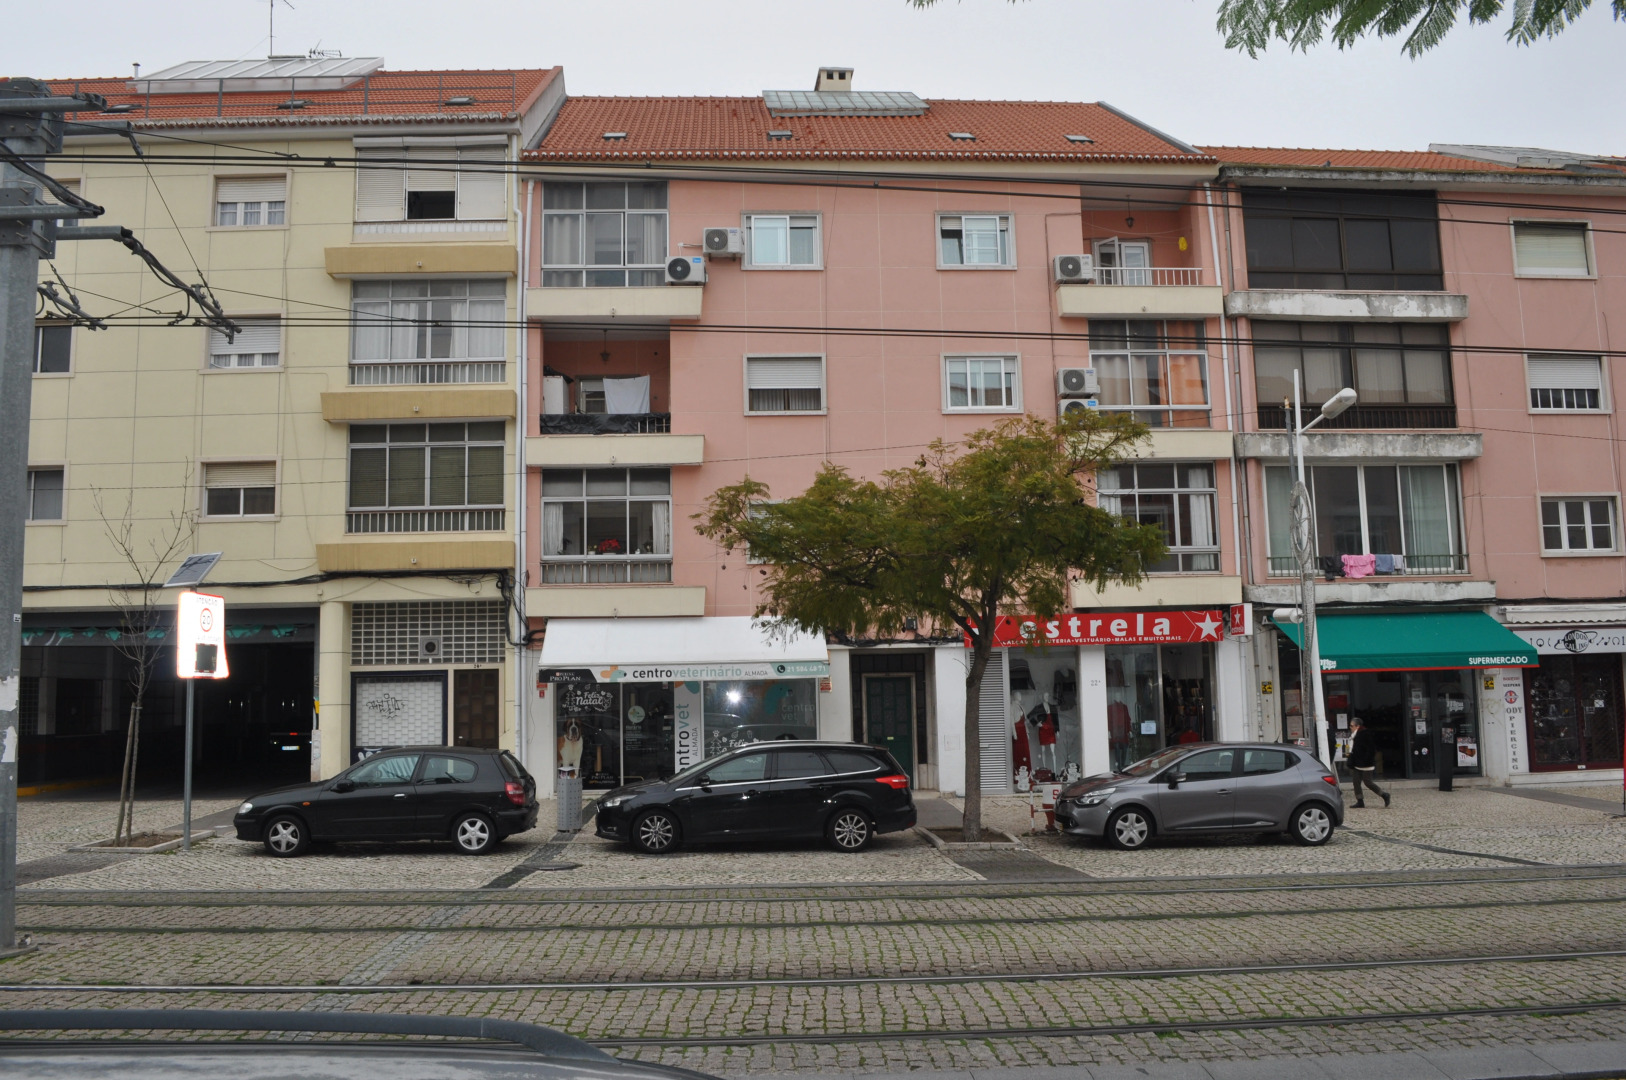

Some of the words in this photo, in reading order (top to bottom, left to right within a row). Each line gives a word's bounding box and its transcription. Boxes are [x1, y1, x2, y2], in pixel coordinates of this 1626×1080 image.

[202, 615, 211, 625] 20
[1020, 613, 1170, 639] estrela
[1074, 635, 1112, 644] VESTUÁRIO
[1564, 632, 1588, 641] LONDON
[1468, 655, 1528, 665] SUPERMERCADO
[632, 665, 742, 679] centroveterinário
[584, 691, 601, 699] Feliz
[575, 696, 603, 706] Natal
[781, 703, 815, 712] centro
[1508, 715, 1520, 771] PIERCING
